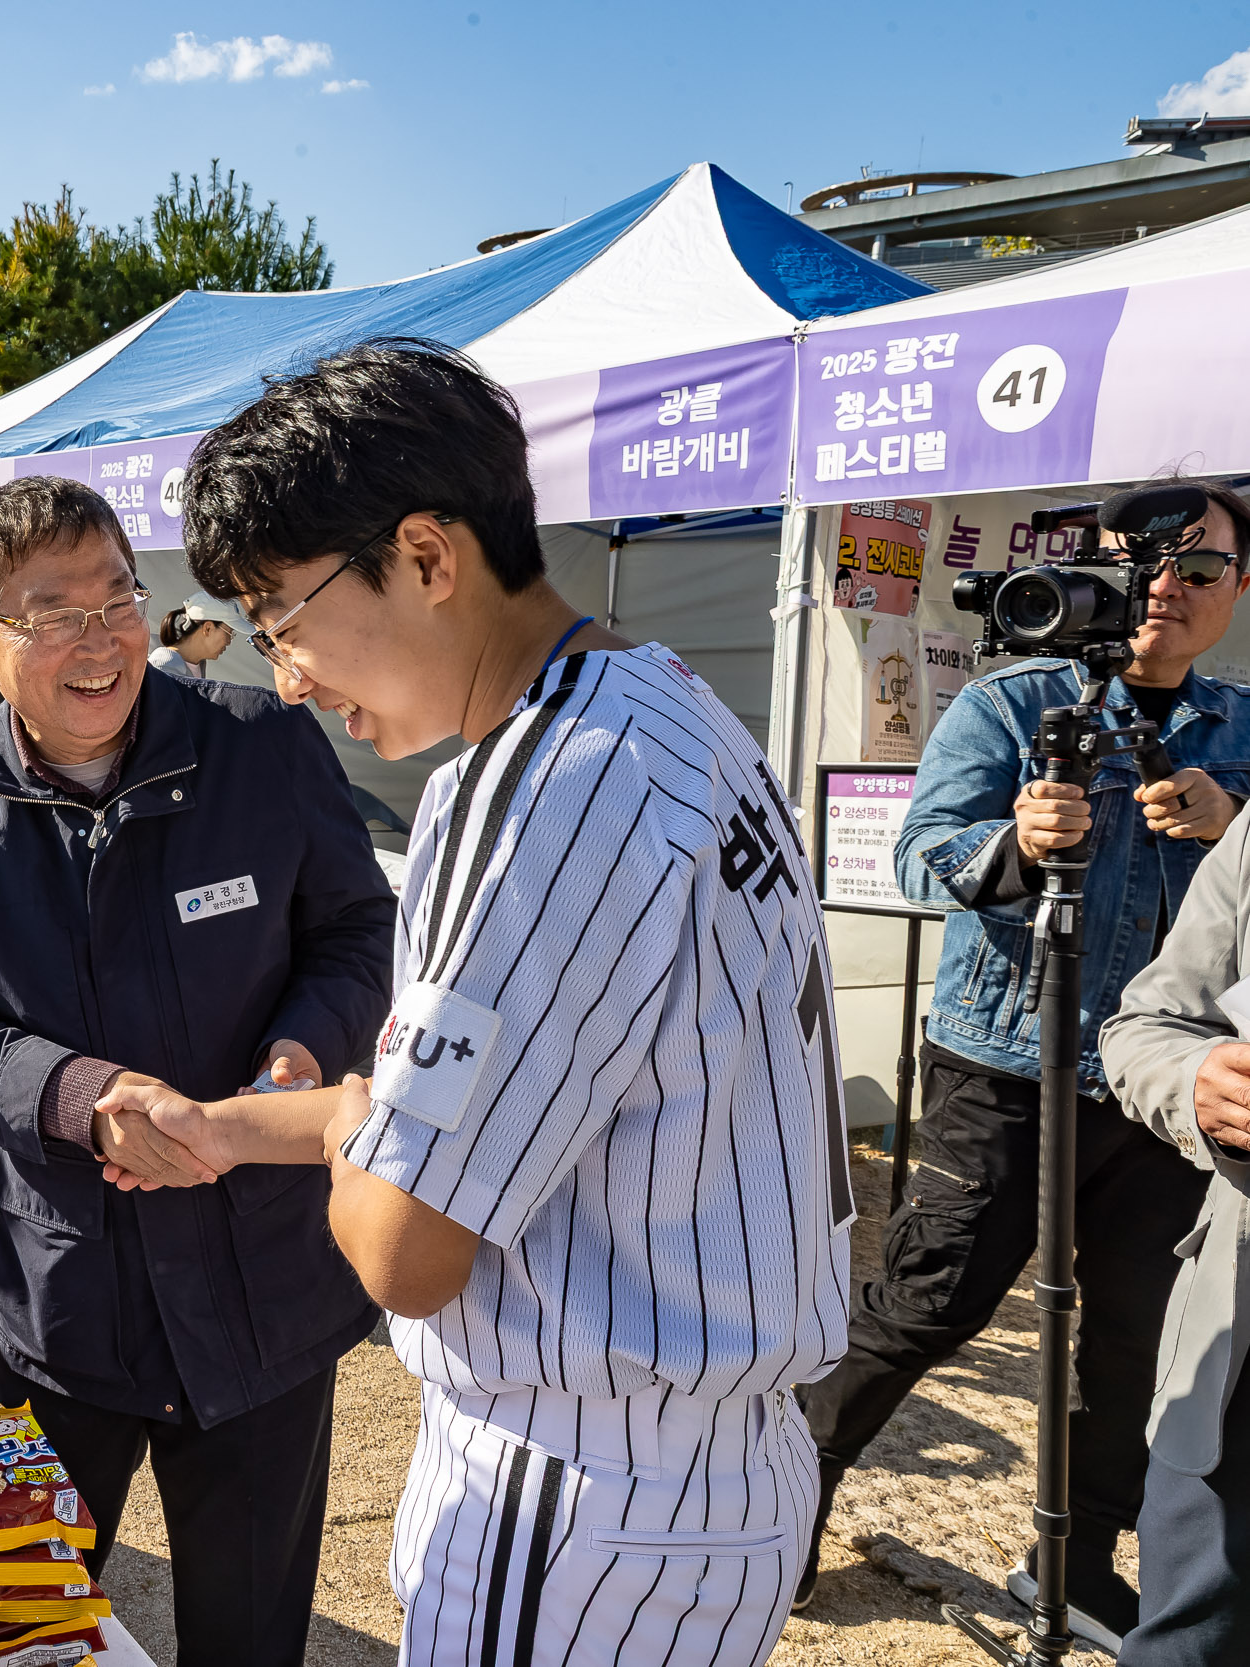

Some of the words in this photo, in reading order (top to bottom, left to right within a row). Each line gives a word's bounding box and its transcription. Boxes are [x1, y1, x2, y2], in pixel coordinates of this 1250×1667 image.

[820, 350, 878, 382] 2025
[883, 331, 961, 373] 광진
[656, 380, 723, 427] 광클
[991, 365, 1048, 409] 41
[833, 379, 935, 433] 청소년
[100, 463, 124, 479] 2025
[124, 455, 154, 479] 광진
[620, 426, 750, 482] 바람개비
[814, 429, 947, 483] 페스티벌
[103, 484, 145, 509] 청소년
[837, 533, 862, 571] 2.
[866, 536, 925, 583] 전시코너
[925, 646, 960, 669] 차이와
[884, 720, 911, 735] 양성평등
[853, 777, 910, 793] 양성평등이
[844, 806, 889, 820] 양성평등
[842, 857, 876, 871] 성차별
[212, 896, 245, 910] 광진구청장
[408, 1026, 476, 1069] U+
